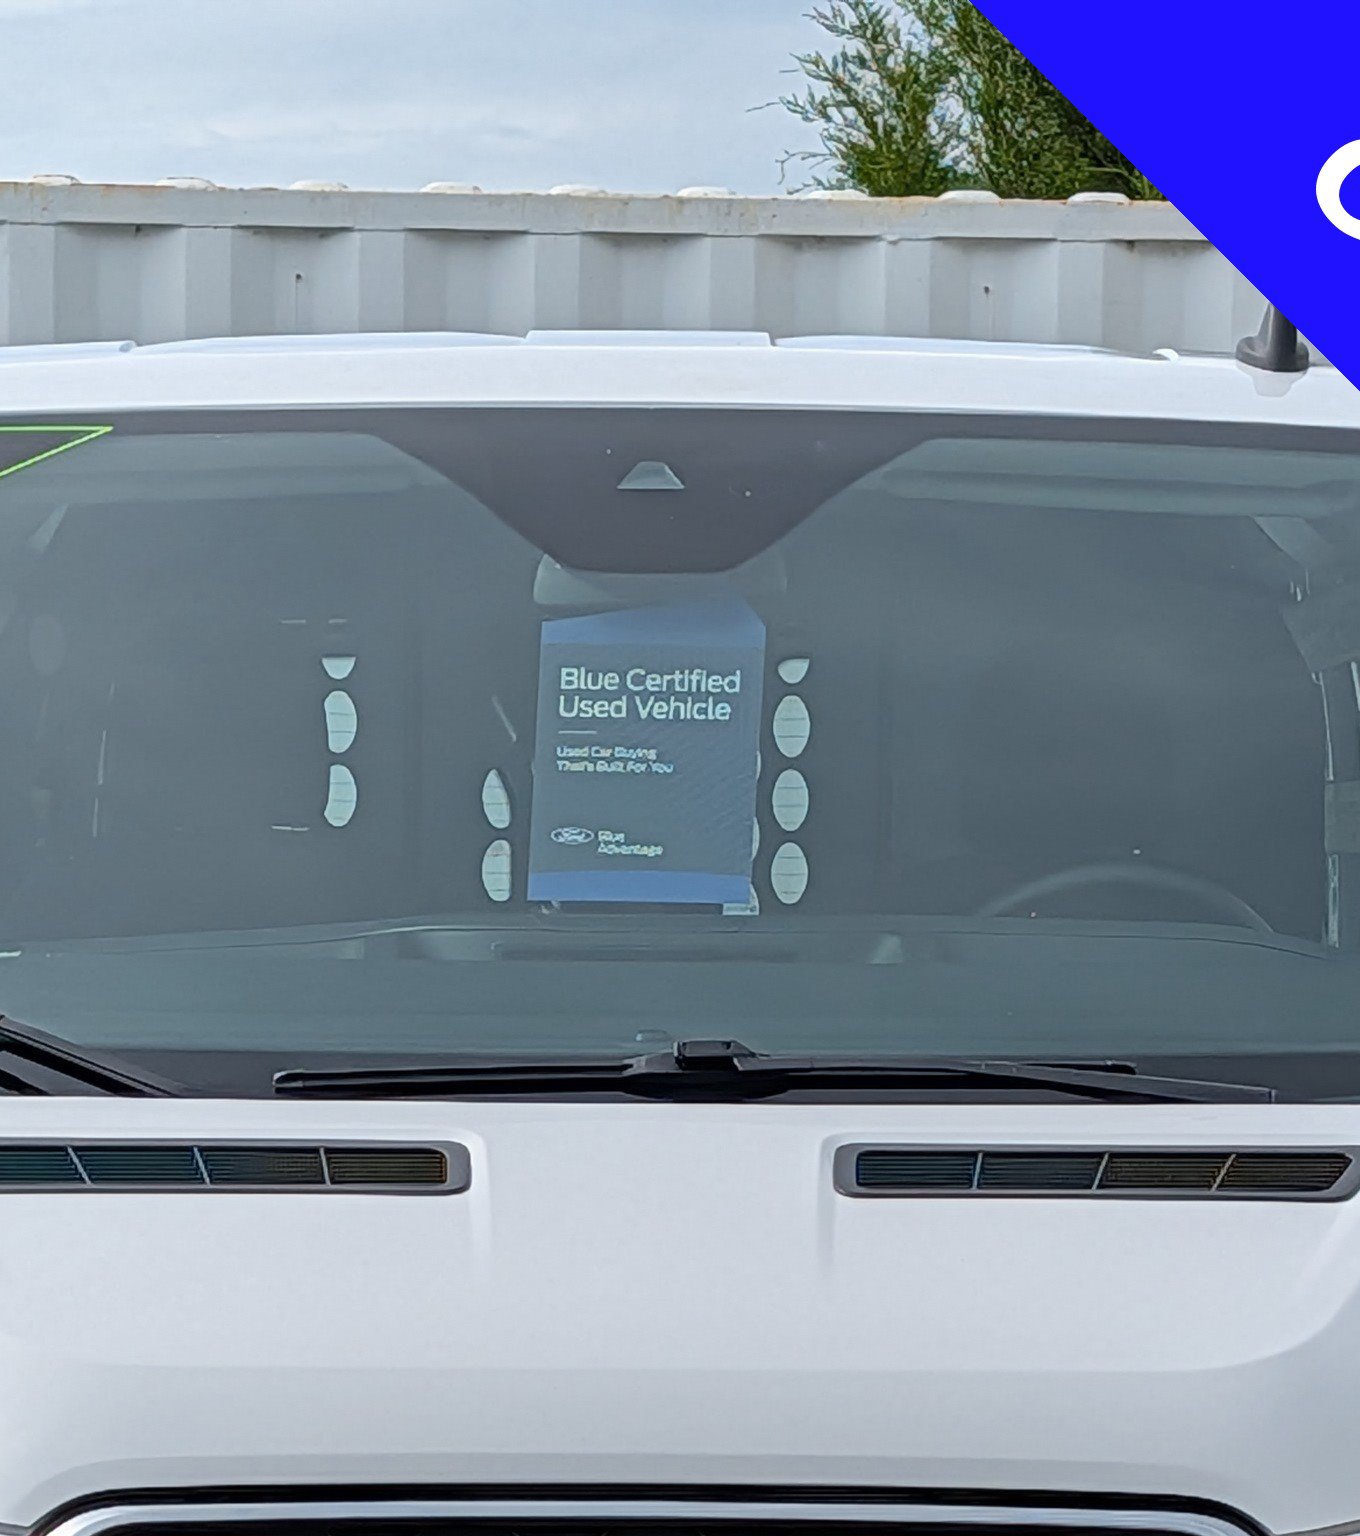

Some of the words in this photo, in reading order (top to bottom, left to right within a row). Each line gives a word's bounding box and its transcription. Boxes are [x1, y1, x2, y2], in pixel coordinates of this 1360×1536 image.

[560, 667, 620, 690] Blue
[626, 668, 741, 693] Certified
[558, 695, 627, 718] Used
[635, 695, 731, 720] Vehicle
[557, 746, 589, 758] Used
